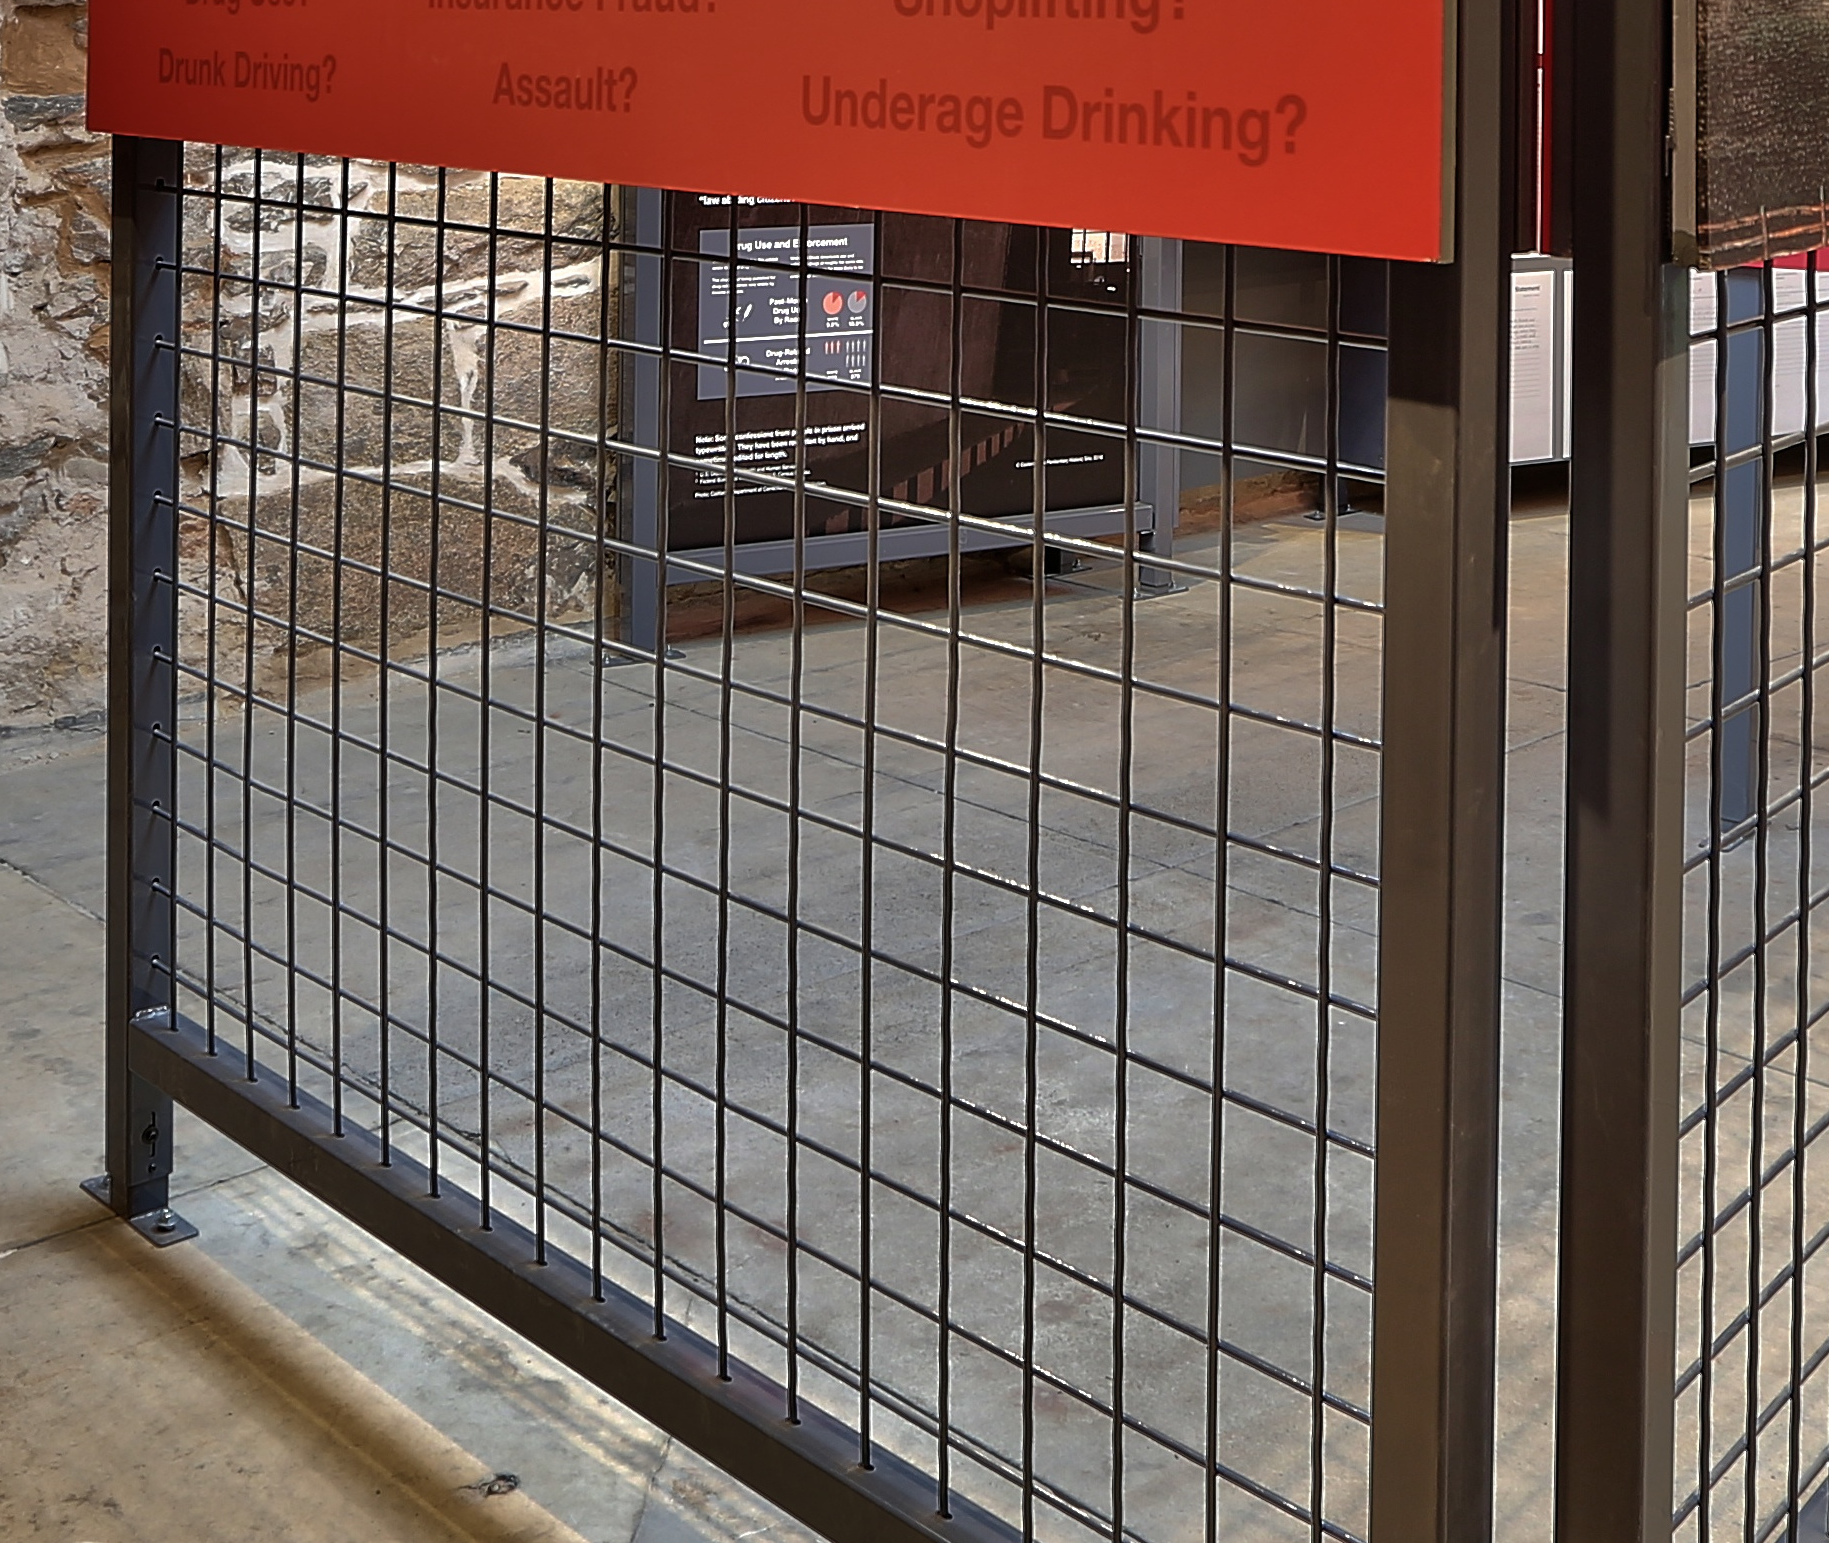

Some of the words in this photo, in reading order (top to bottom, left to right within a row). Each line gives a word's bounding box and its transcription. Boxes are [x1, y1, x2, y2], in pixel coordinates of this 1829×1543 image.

[158, 48, 227, 88] Drunk
[234, 51, 337, 102] Driving?
[492, 62, 638, 113] Assault?
[801, 75, 1025, 149] Underage
[1042, 84, 1308, 168] Drinking?
[737, 241, 752, 252] rug
[754, 239, 771, 250] Use
[774, 238, 790, 249] and
[793, 237, 848, 248] Eorcement
[738, 442, 754, 452] They
[755, 441, 770, 450] have
[771, 440, 788, 449] been
